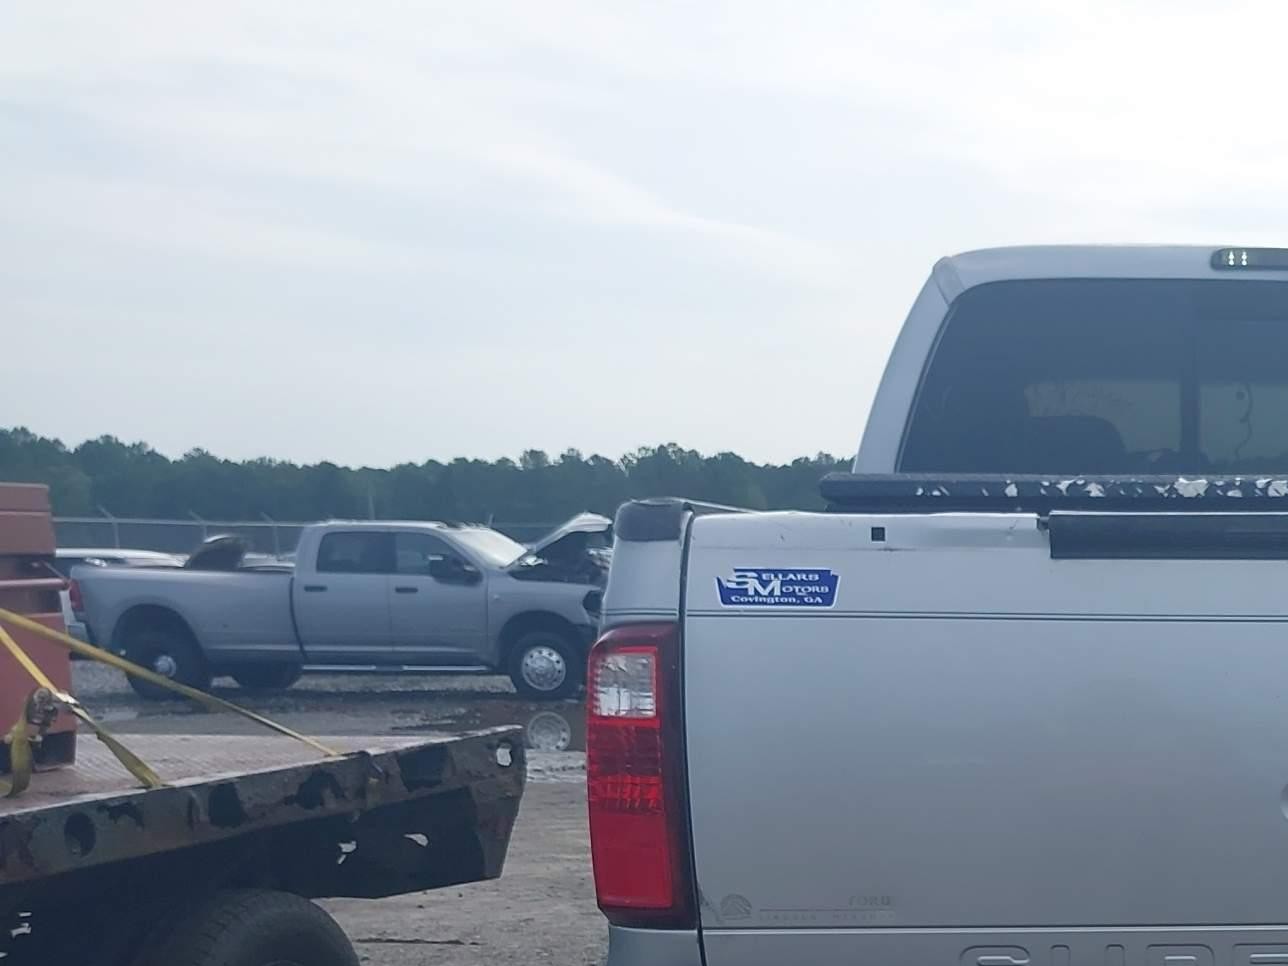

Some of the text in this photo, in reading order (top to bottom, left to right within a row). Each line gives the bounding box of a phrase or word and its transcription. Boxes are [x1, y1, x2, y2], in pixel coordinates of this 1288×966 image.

[726, 571, 820, 590] SELLARS
[747, 579, 830, 597] MOTORS
[803, 596, 823, 604] GA
